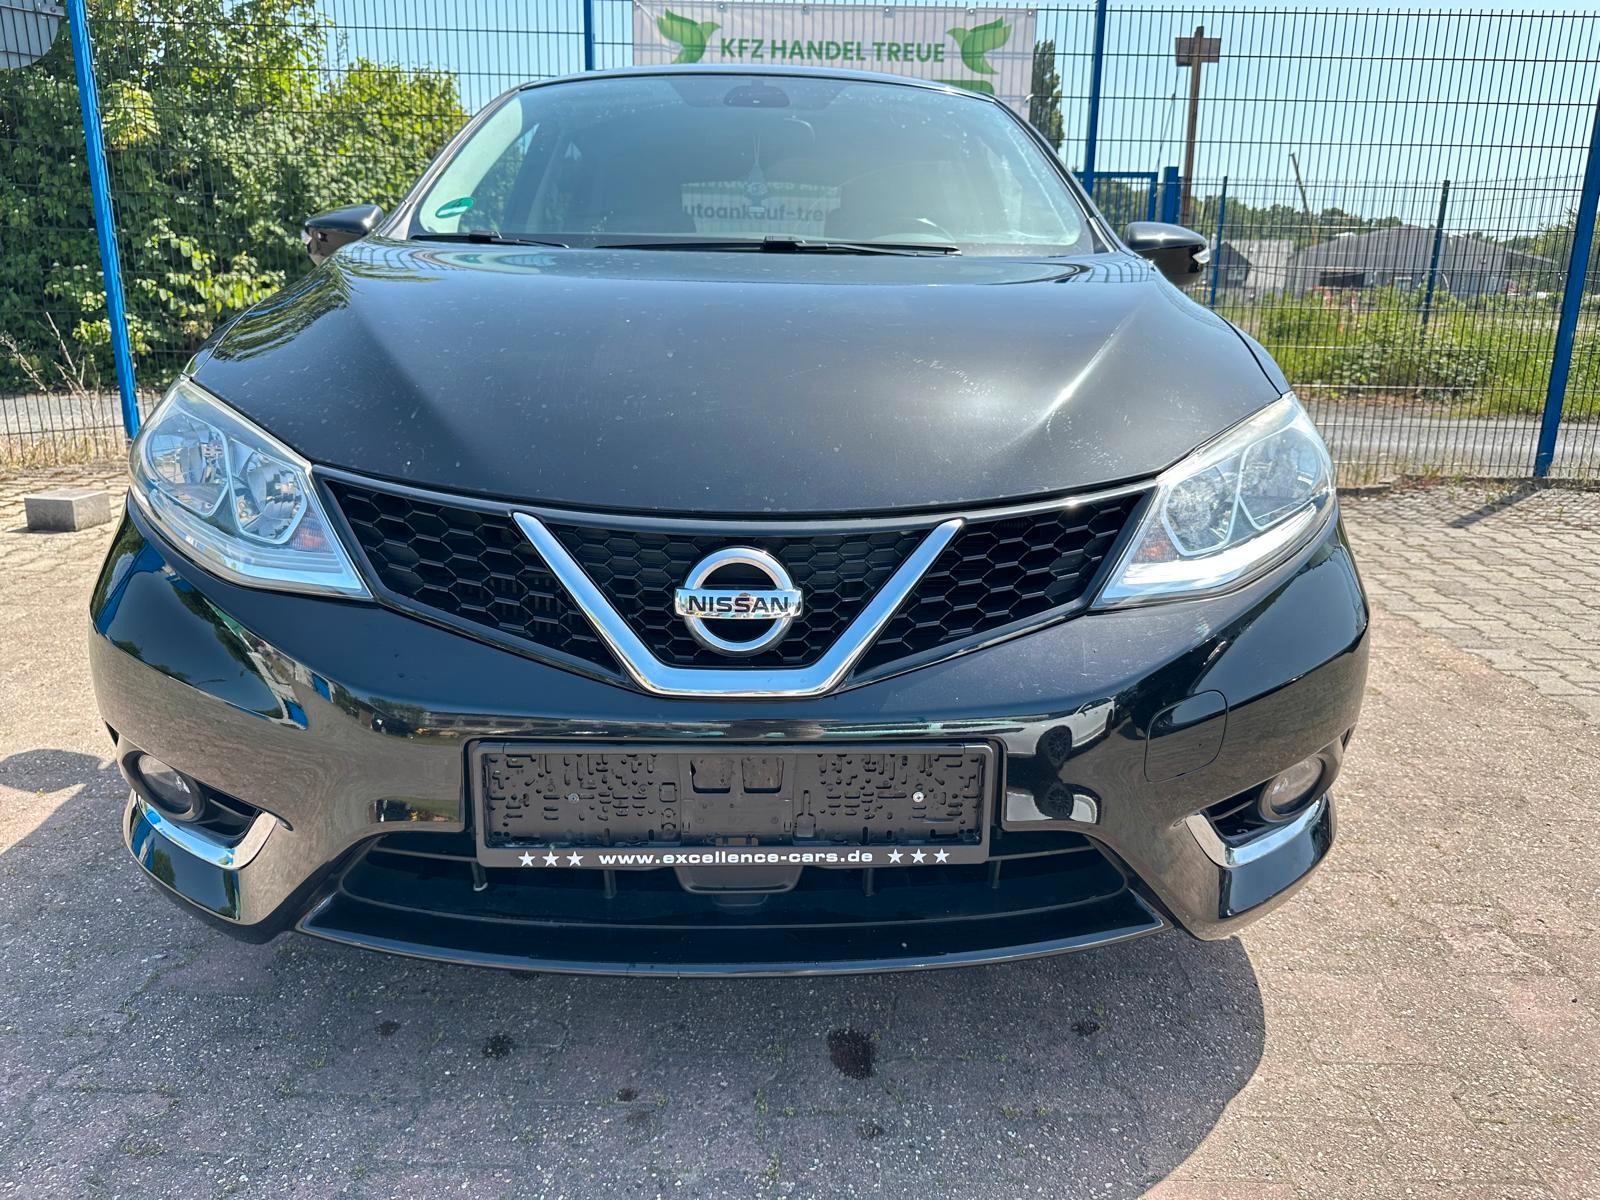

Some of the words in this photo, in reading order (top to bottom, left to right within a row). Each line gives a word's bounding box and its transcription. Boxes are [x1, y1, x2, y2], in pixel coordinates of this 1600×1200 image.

[720, 37, 764, 58] KFZ
[770, 39, 867, 61] HANDEL
[872, 41, 945, 63] TREUE
[688, 595, 789, 613] NISSAN
[598, 849, 873, 865] www.excellence-cars.de
